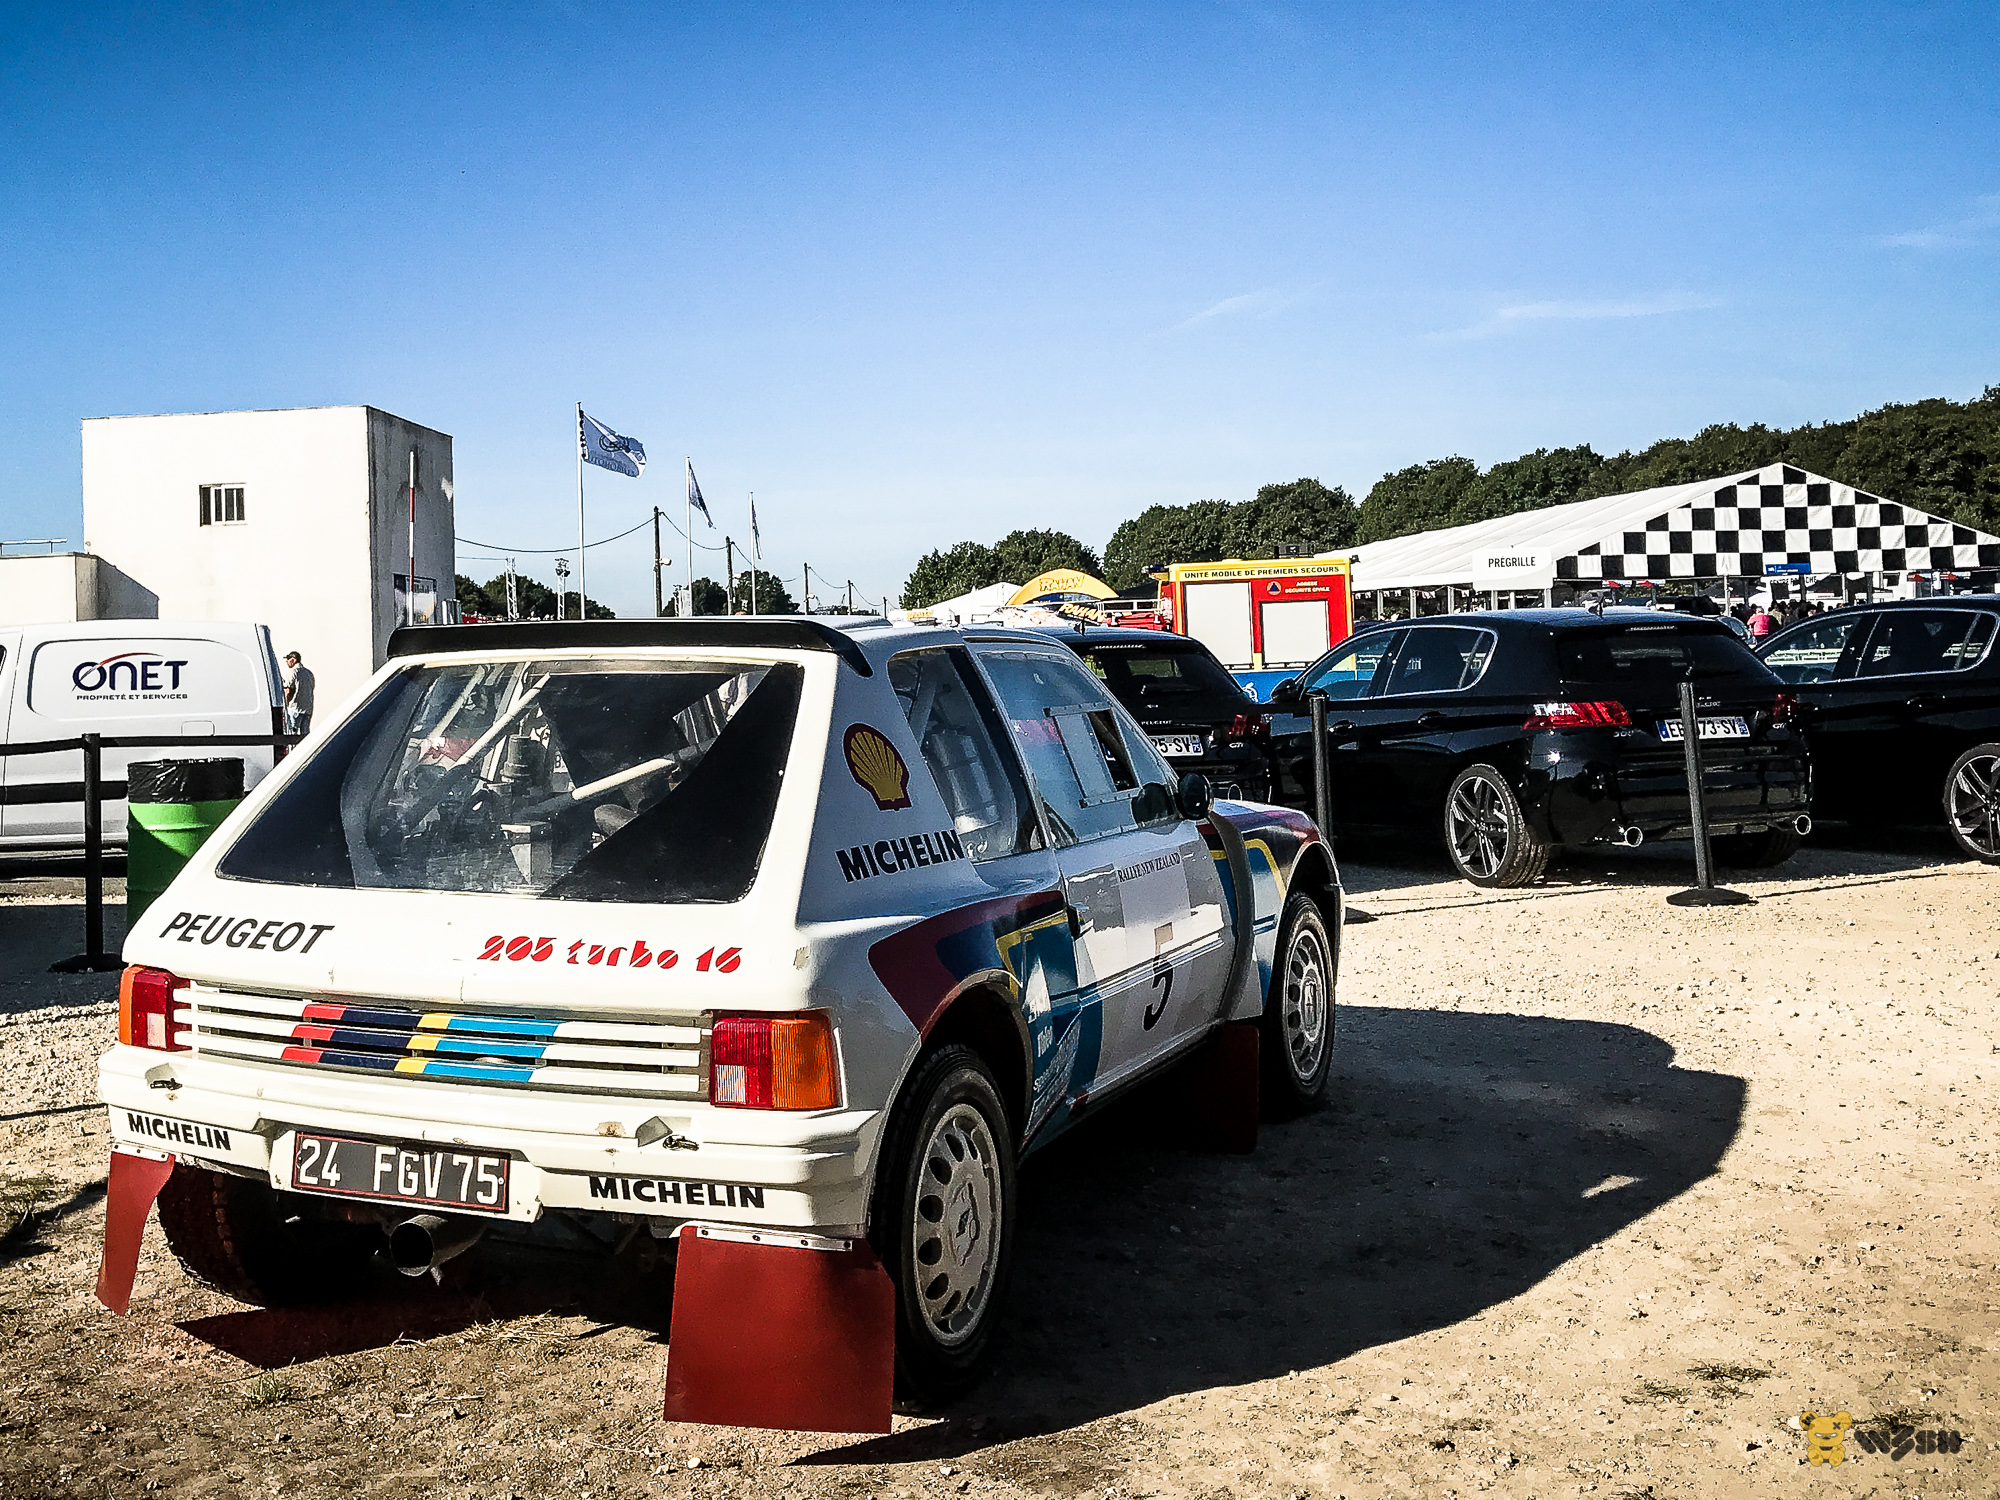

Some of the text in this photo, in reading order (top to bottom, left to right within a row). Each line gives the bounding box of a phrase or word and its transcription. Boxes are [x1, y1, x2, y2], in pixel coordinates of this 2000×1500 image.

[1038, 575, 1085, 592] RAHAN
[1184, 566, 1340, 579] UNITE MOBILE DE PREMIERS SECOURS
[1058, 602, 1107, 623] RAHAN
[835, 829, 965, 882] MICHELIN
[1116, 852, 1181, 883] RALLYE NEW ZEALAND
[159, 912, 335, 954] PEUGEOT
[477, 935, 743, 973] 205 turbo 16
[127, 1113, 231, 1151] MICHELIN
[300, 1138, 500, 1205] 24 FGV 75
[589, 1176, 765, 1208] MICHELIN
